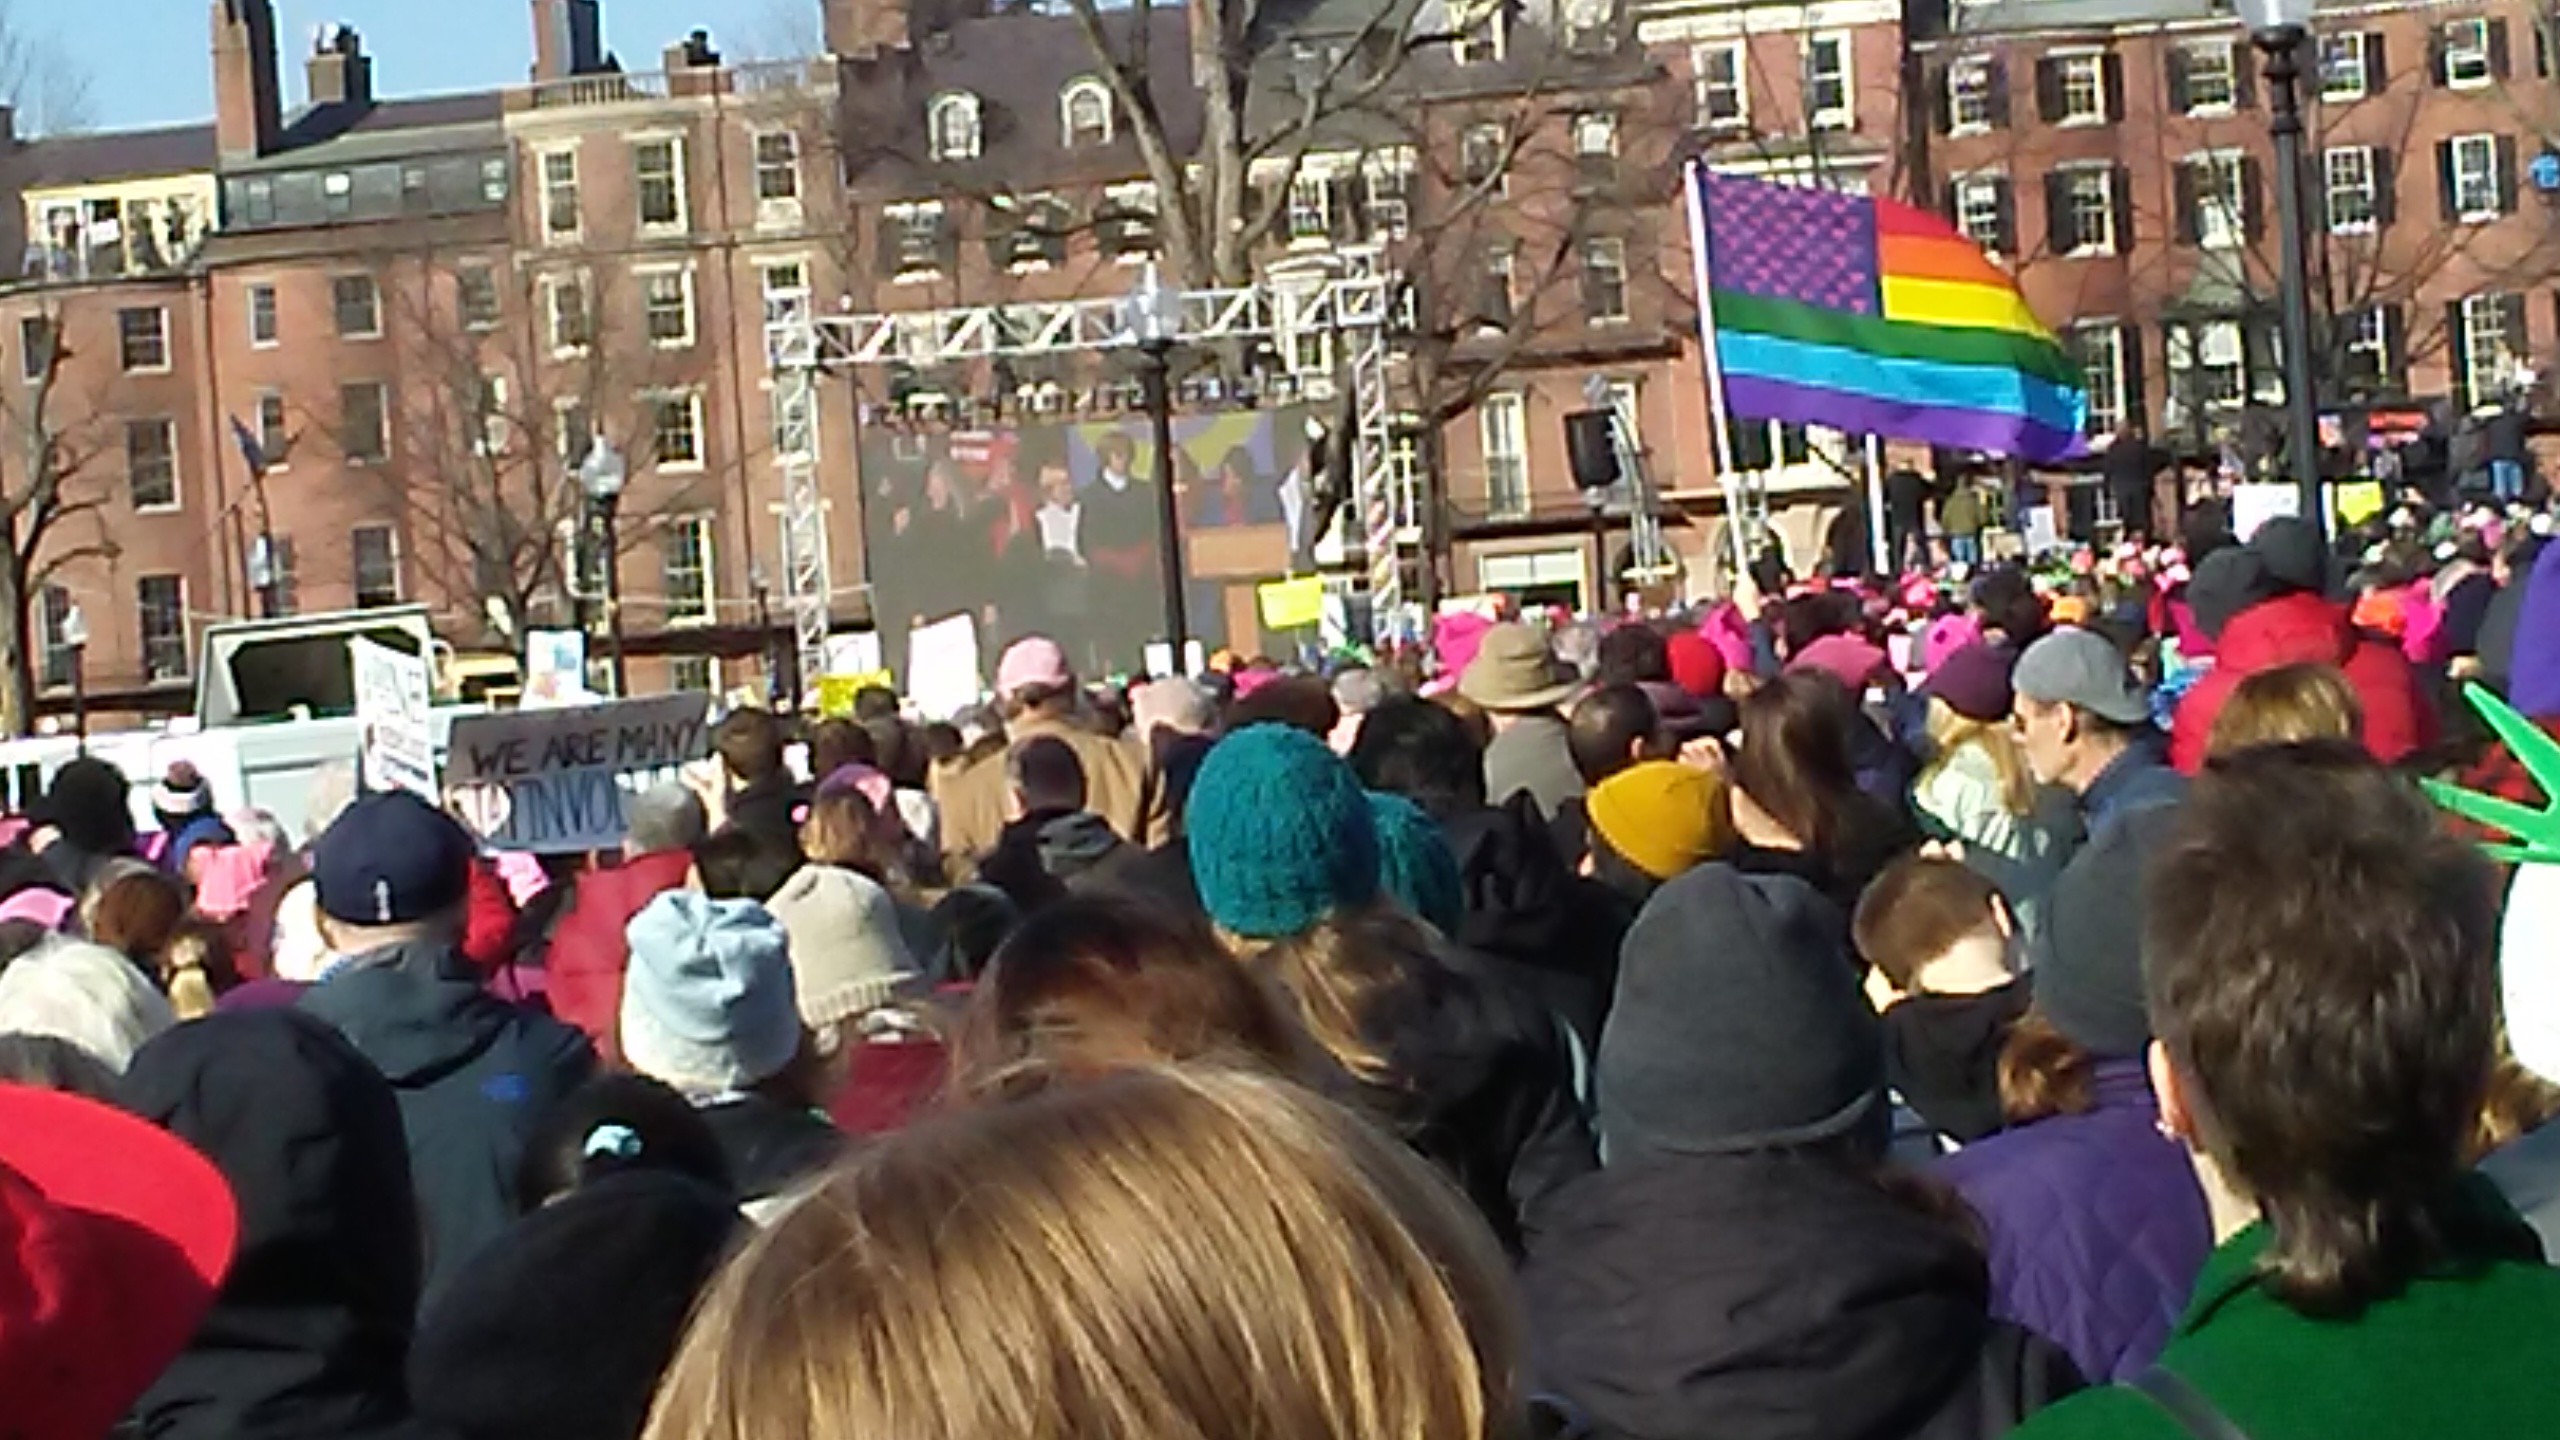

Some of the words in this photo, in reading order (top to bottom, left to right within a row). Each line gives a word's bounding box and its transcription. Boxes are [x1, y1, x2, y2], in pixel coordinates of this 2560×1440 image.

[470, 738, 529, 777] WE
[541, 729, 606, 768] ARE
[617, 719, 702, 761] MANY
